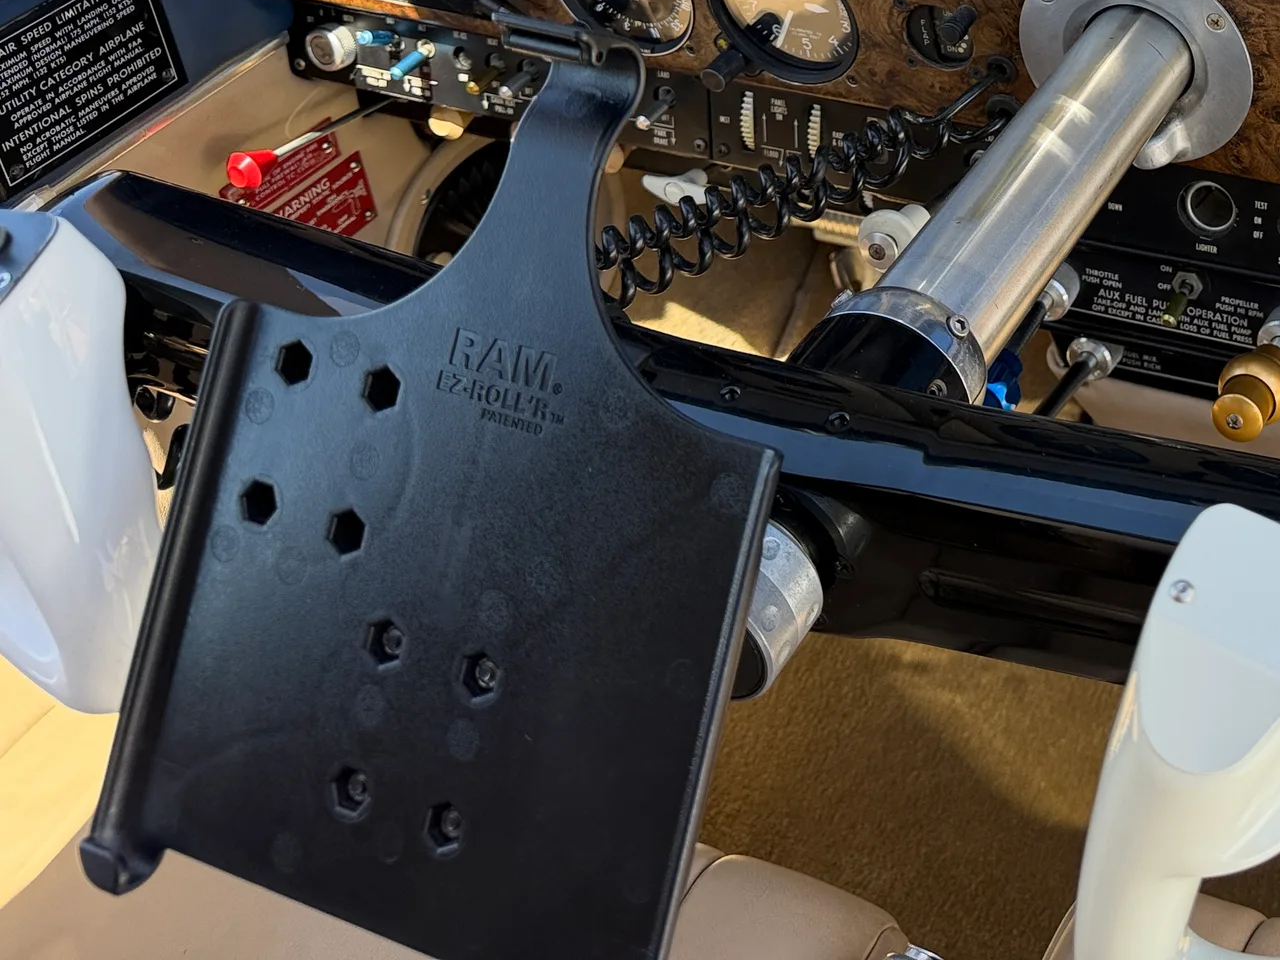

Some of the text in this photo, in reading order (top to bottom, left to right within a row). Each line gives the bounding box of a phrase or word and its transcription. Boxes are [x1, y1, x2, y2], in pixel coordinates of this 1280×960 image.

[77, 4, 110, 30] LANDING
[20, 22, 52, 45] SPEED
[39, 21, 146, 90] CATEGORY AIRPLANE
[1, 47, 162, 153] INTENTIONAL SPINS PROHIBITED
[1196, 243, 1217, 254] LIGHTER
[1085, 268, 1119, 281] THROTTLE
[1098, 289, 1248, 327] AUX FUEL OPERATION
[1221, 296, 1259, 310] PROPELLER
[480, 407, 543, 436] PATENTED
